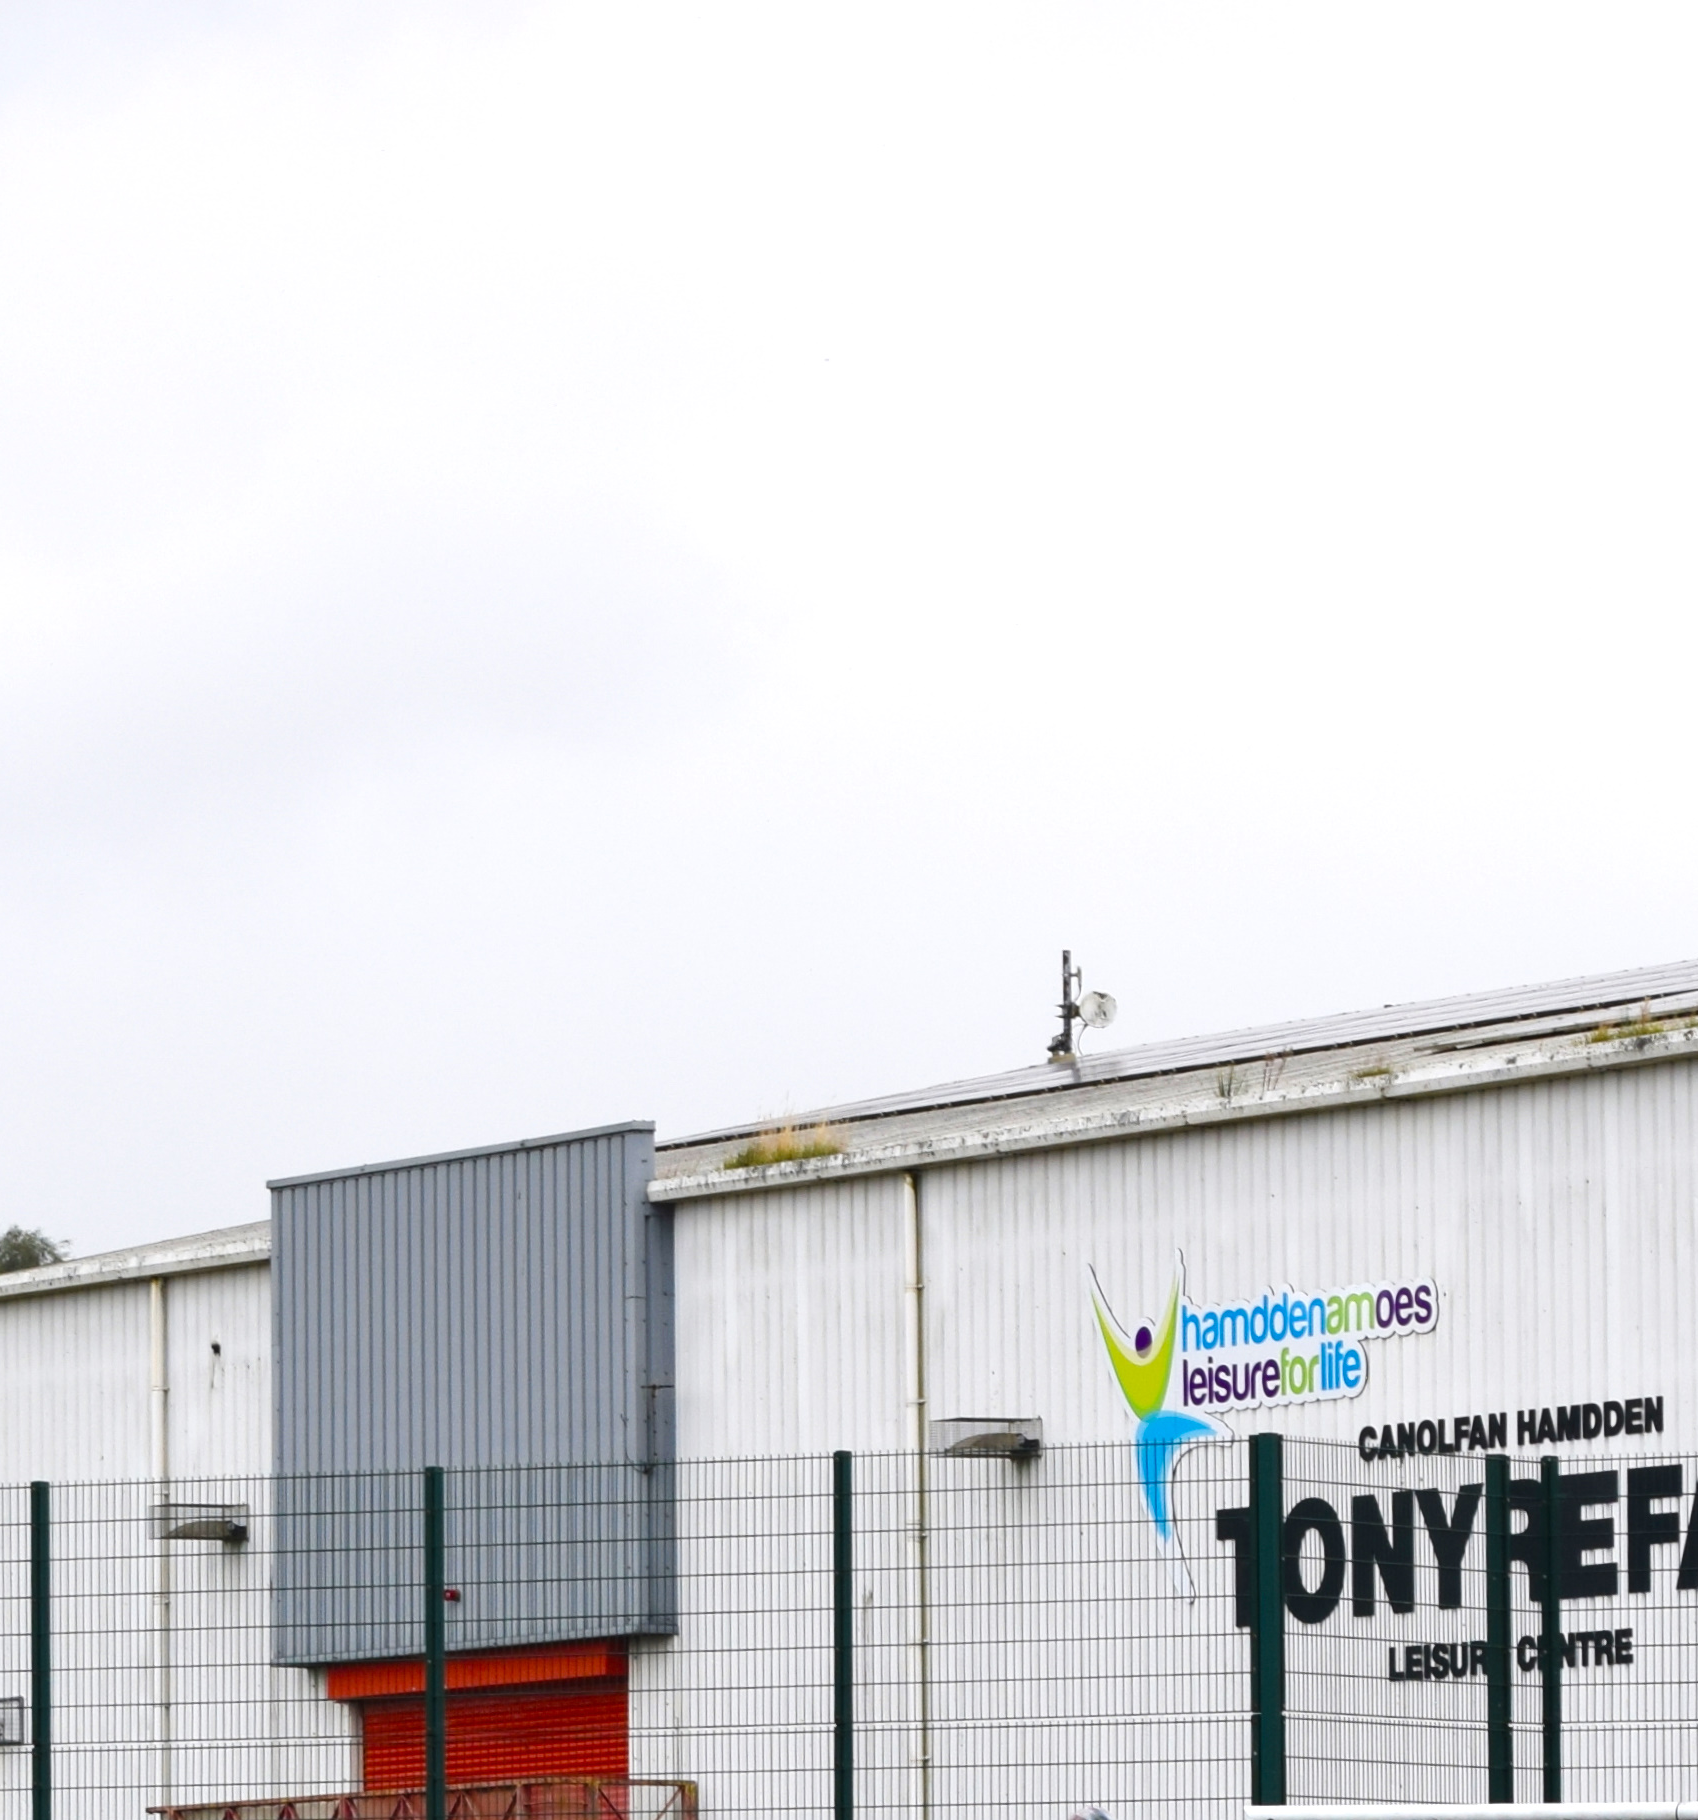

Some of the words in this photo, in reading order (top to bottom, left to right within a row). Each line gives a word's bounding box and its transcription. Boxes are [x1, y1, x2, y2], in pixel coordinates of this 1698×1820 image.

[1182, 1285, 1433, 1352] hamddenamoes
[1182, 1340, 1361, 1407] leisureforlife
[1358, 1411, 1508, 1462] CANOLFAN
[1517, 1395, 1664, 1446] HAMDDEN
[1388, 1640, 1491, 1682] LEISUR
[1517, 1628, 1634, 1672] CNTRE
